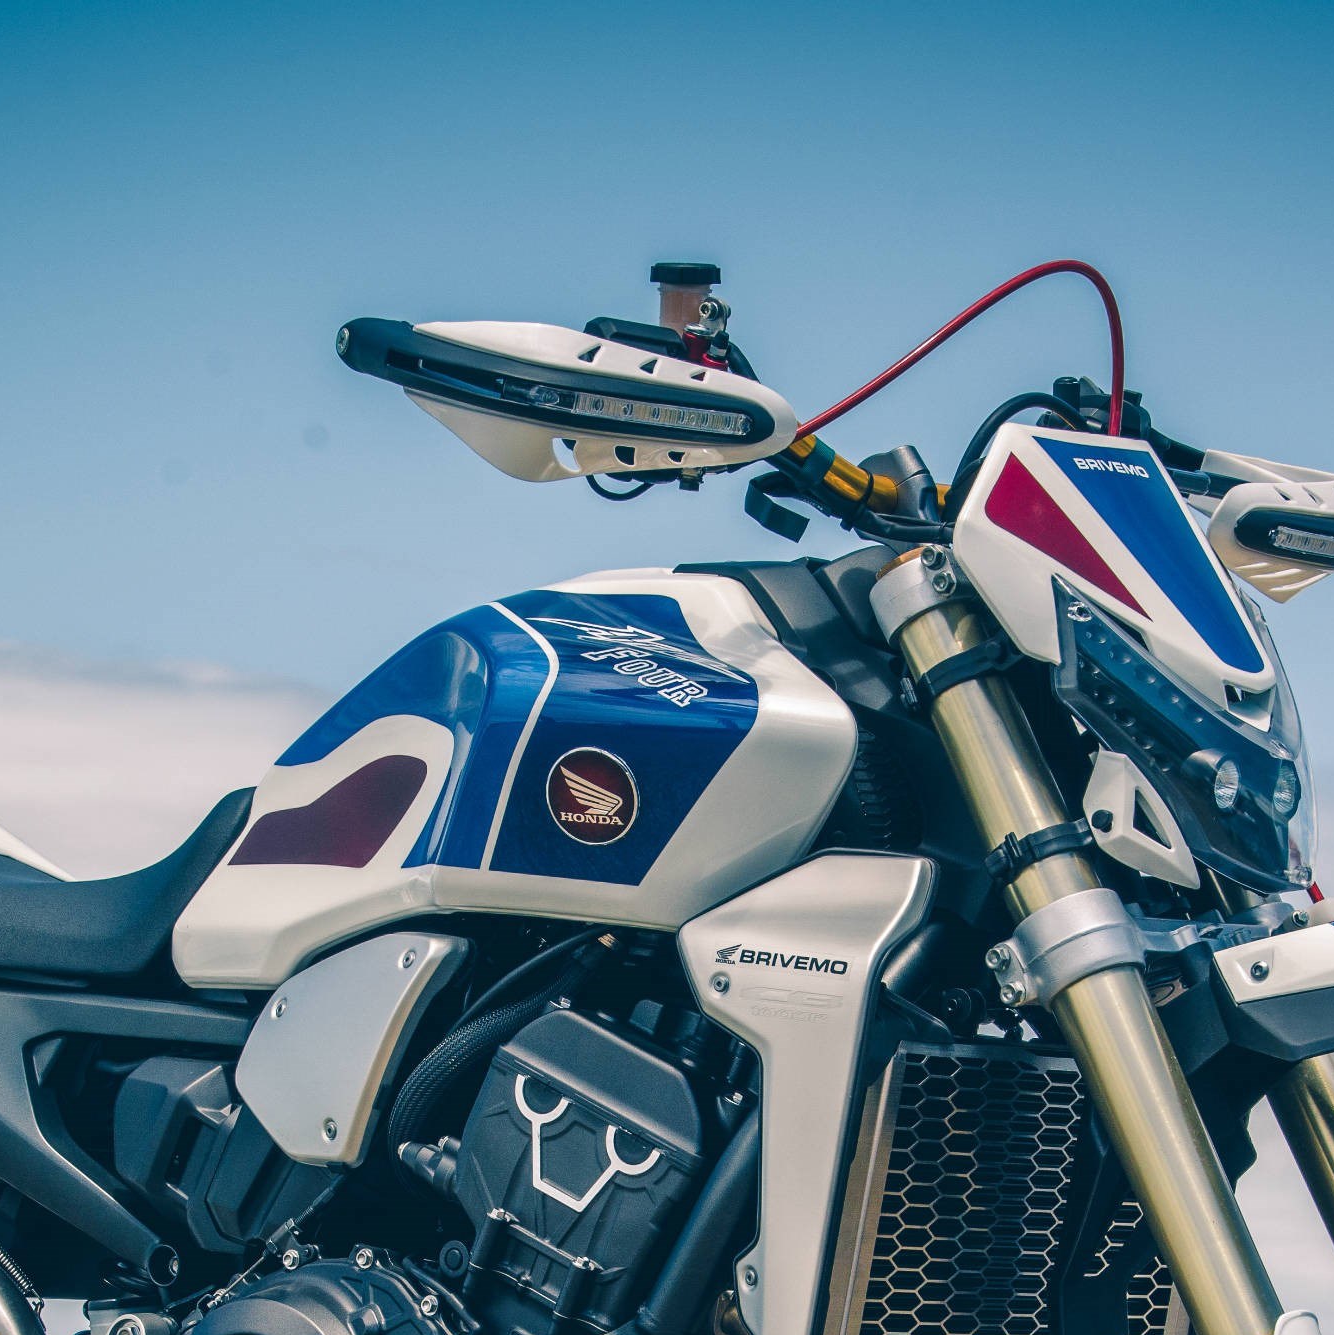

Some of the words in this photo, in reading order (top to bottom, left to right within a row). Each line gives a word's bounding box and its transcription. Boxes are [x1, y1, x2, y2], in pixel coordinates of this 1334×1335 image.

[1072, 457, 1150, 478] BRIVEMO
[580, 646, 709, 708] FOUR
[560, 811, 624, 826] HONDA
[739, 949, 848, 975] BRIVEMO
